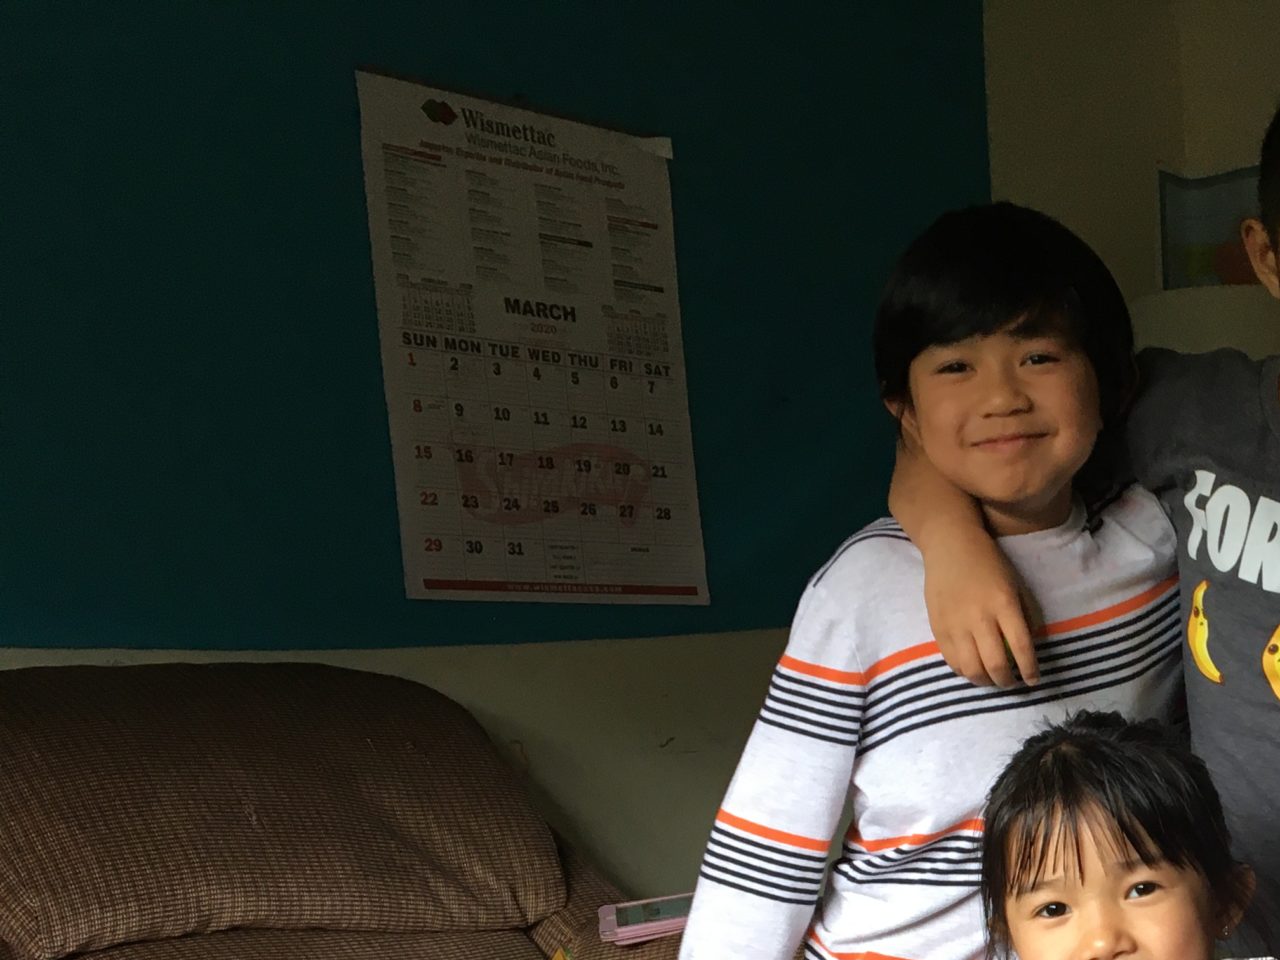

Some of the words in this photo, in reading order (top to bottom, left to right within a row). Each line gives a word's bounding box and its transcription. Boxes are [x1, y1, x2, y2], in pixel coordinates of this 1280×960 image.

[461, 107, 556, 147] Wismettac
[504, 297, 577, 322] MARCH
[530, 323, 557, 334] 2020
[402, 332, 438, 348] SUN
[444, 338, 481, 354] MON
[488, 343, 520, 359] TUE
[528, 348, 561, 364] WED
[568, 353, 600, 369] THU
[610, 360, 633, 372] FRI
[644, 363, 671, 378] SAT
[407, 353, 416, 366] 1
[450, 357, 459, 370] 2
[493, 362, 501, 376] 3
[532, 368, 542, 380] 4
[571, 372, 580, 384] 5
[610, 377, 619, 390] 6
[648, 381, 655, 394] 7
[413, 400, 422, 412] 8
[454, 403, 464, 417] 9
[494, 408, 510, 421] 10
[533, 412, 550, 425] 11
[571, 416, 588, 428] 12
[611, 420, 626, 432] 13
[648, 424, 664, 436] 14
[415, 446, 432, 460] 15
[456, 450, 474, 464] 16
[498, 454, 514, 467] 17
[538, 456, 554, 470] 18
[576, 460, 592, 473] 19
[615, 463, 630, 475] 20
[652, 466, 668, 478] 21
[420, 492, 438, 506] 22
[462, 495, 480, 509] 23
[503, 498, 521, 511] 24
[543, 500, 560, 513] 25
[580, 503, 596, 516] 26
[620, 505, 634, 518] 27
[656, 508, 671, 520] 28
[424, 538, 442, 552] 29
[466, 540, 483, 554] 30
[508, 542, 524, 556] 31
